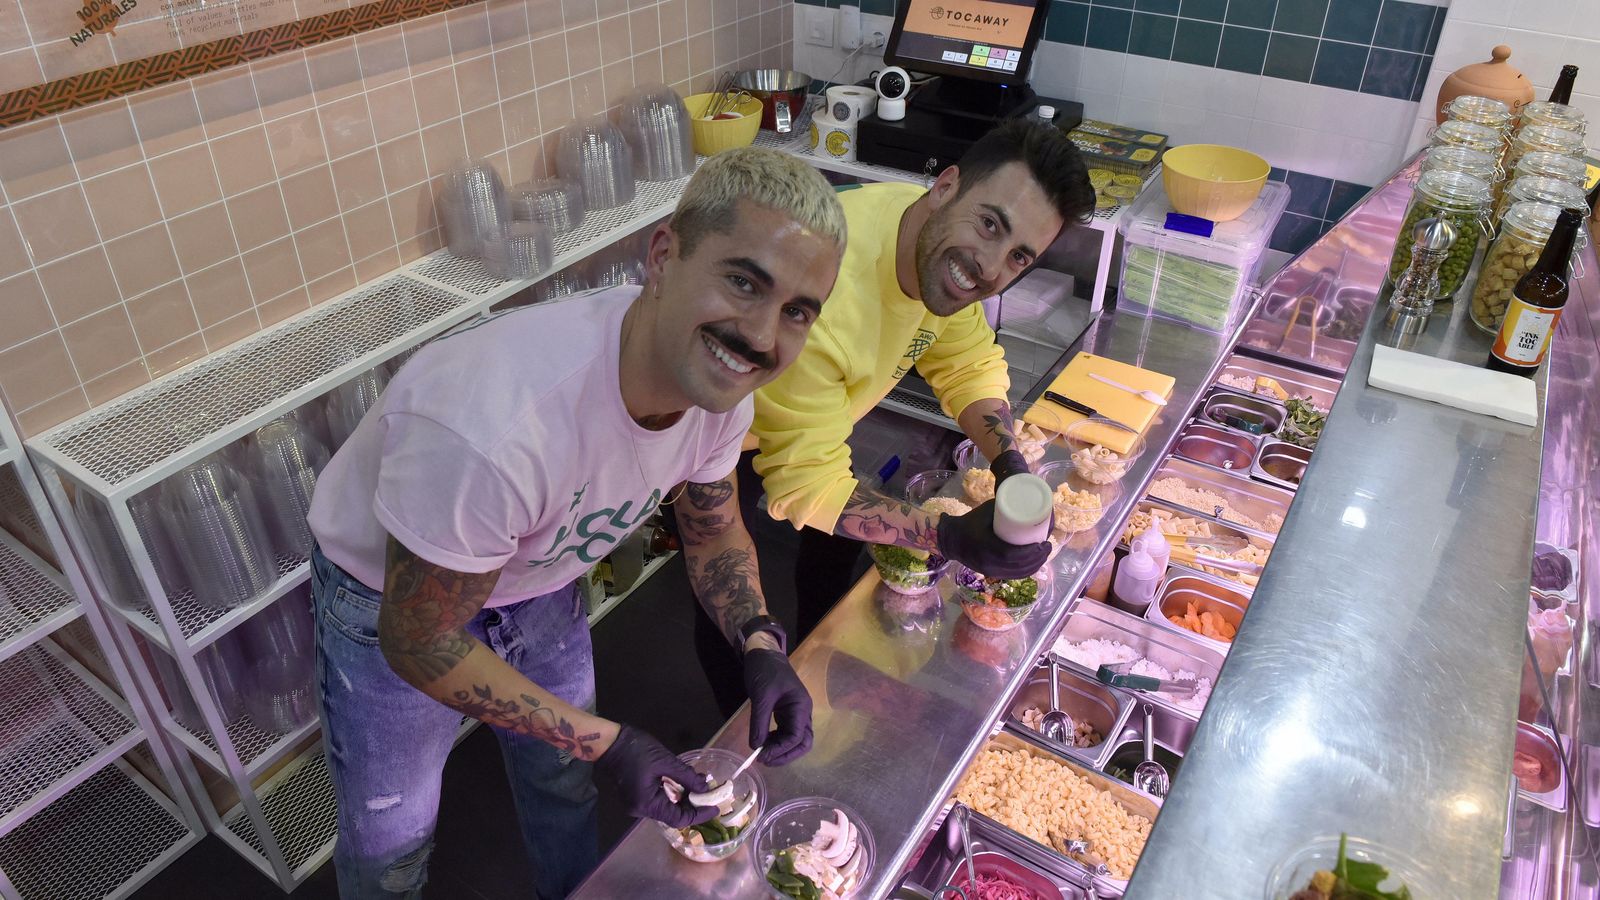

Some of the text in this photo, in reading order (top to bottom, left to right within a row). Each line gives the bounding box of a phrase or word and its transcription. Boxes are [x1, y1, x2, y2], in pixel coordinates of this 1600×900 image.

[70, 0, 137, 47] NATURALES
[186, 16, 195, 25] of
[946, 10, 1009, 27] TOCAWAY
[189, 20, 221, 34] recycled
[1071, 138, 1102, 149] HOLA
[1520, 336, 1538, 345] TOC
